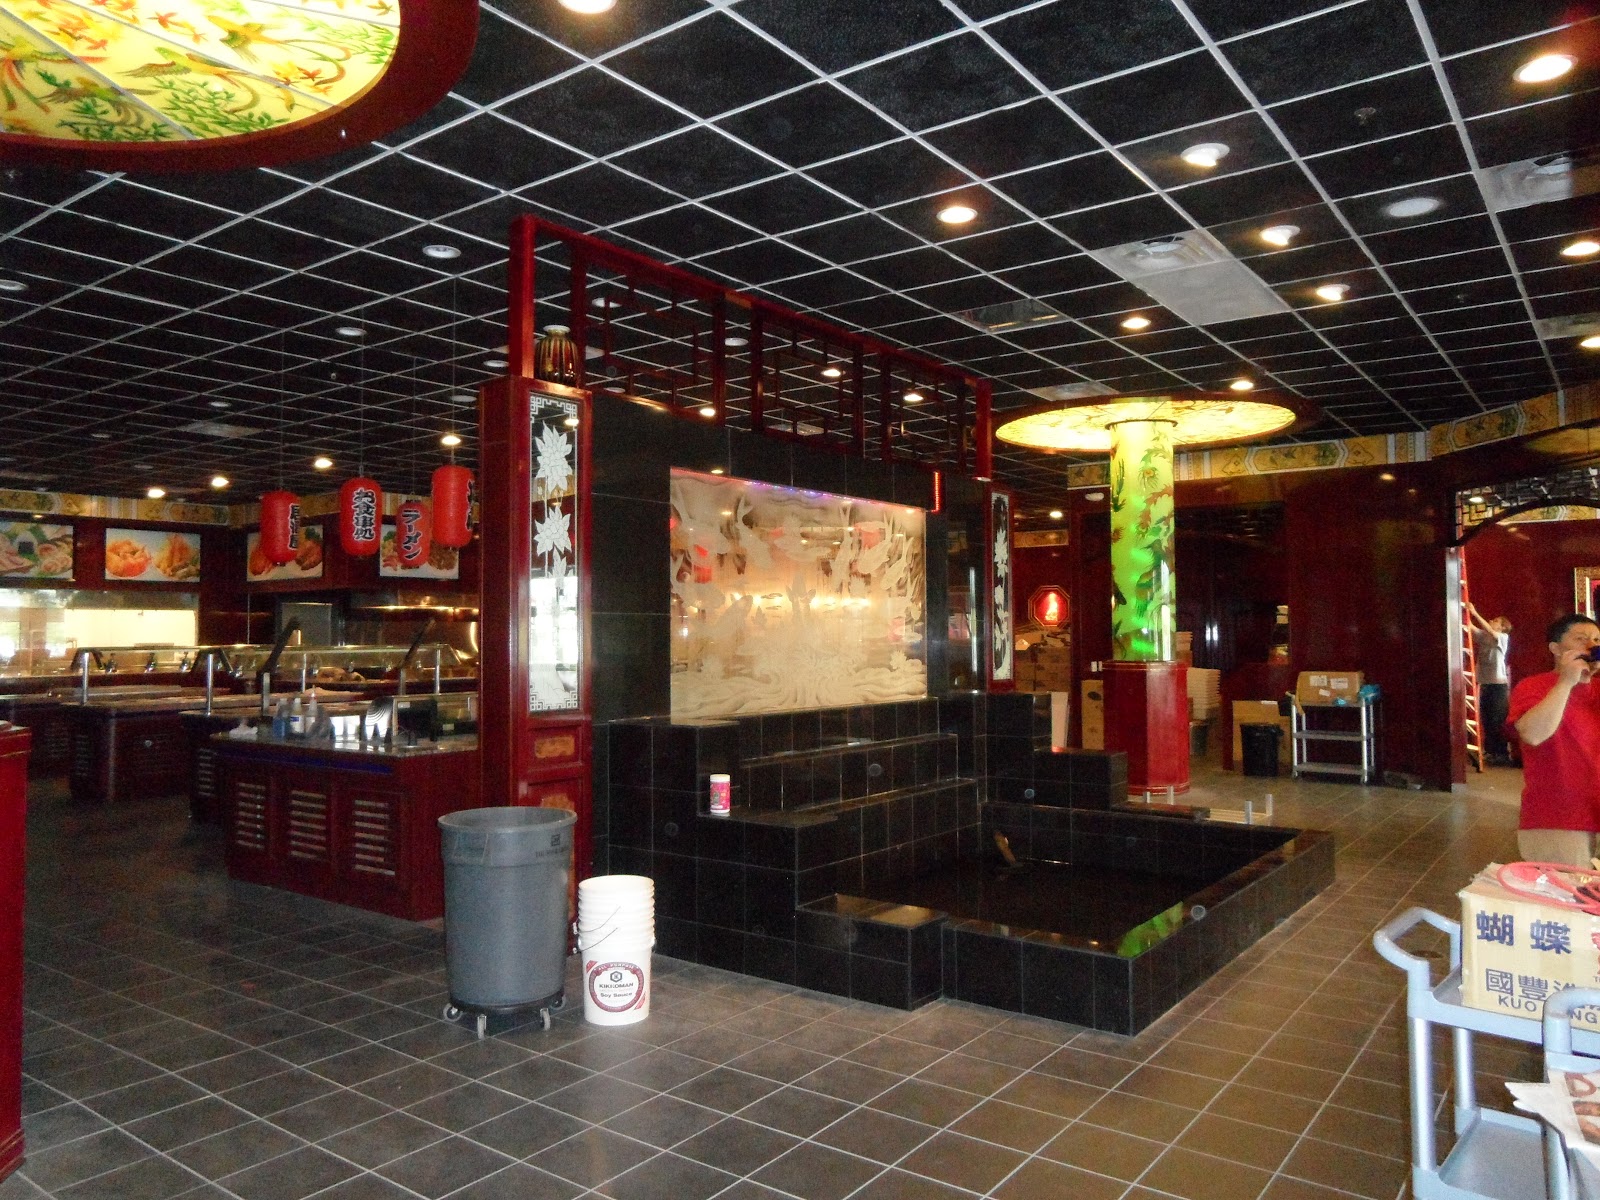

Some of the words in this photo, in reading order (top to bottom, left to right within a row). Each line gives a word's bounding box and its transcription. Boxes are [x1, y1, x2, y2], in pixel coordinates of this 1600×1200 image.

[353, 488, 376, 541] お食事処
[402, 509, 422, 560] ラーメン
[1476, 910, 1571, 954] 蝴蝶
[1486, 968, 1575, 1001] 國豐
[1498, 995, 1537, 1012] KUO
